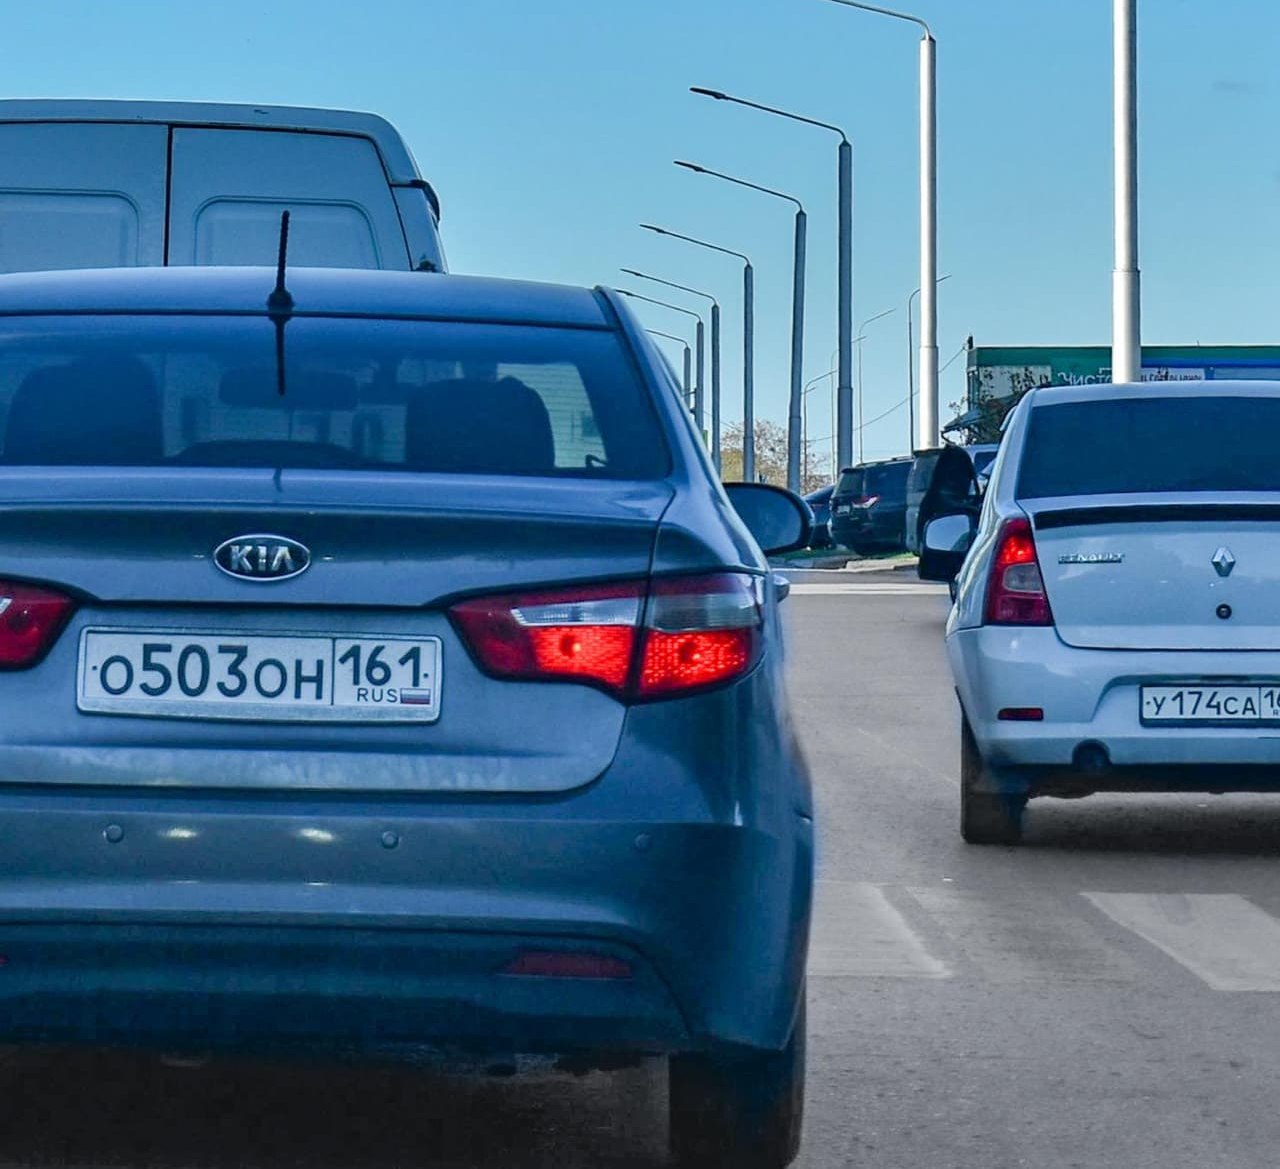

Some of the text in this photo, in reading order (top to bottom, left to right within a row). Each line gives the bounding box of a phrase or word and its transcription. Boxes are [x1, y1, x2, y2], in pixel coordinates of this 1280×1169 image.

[230, 545, 295, 570] KIA
[338, 644, 421, 687] 161
[357, 687, 399, 703] RUS
